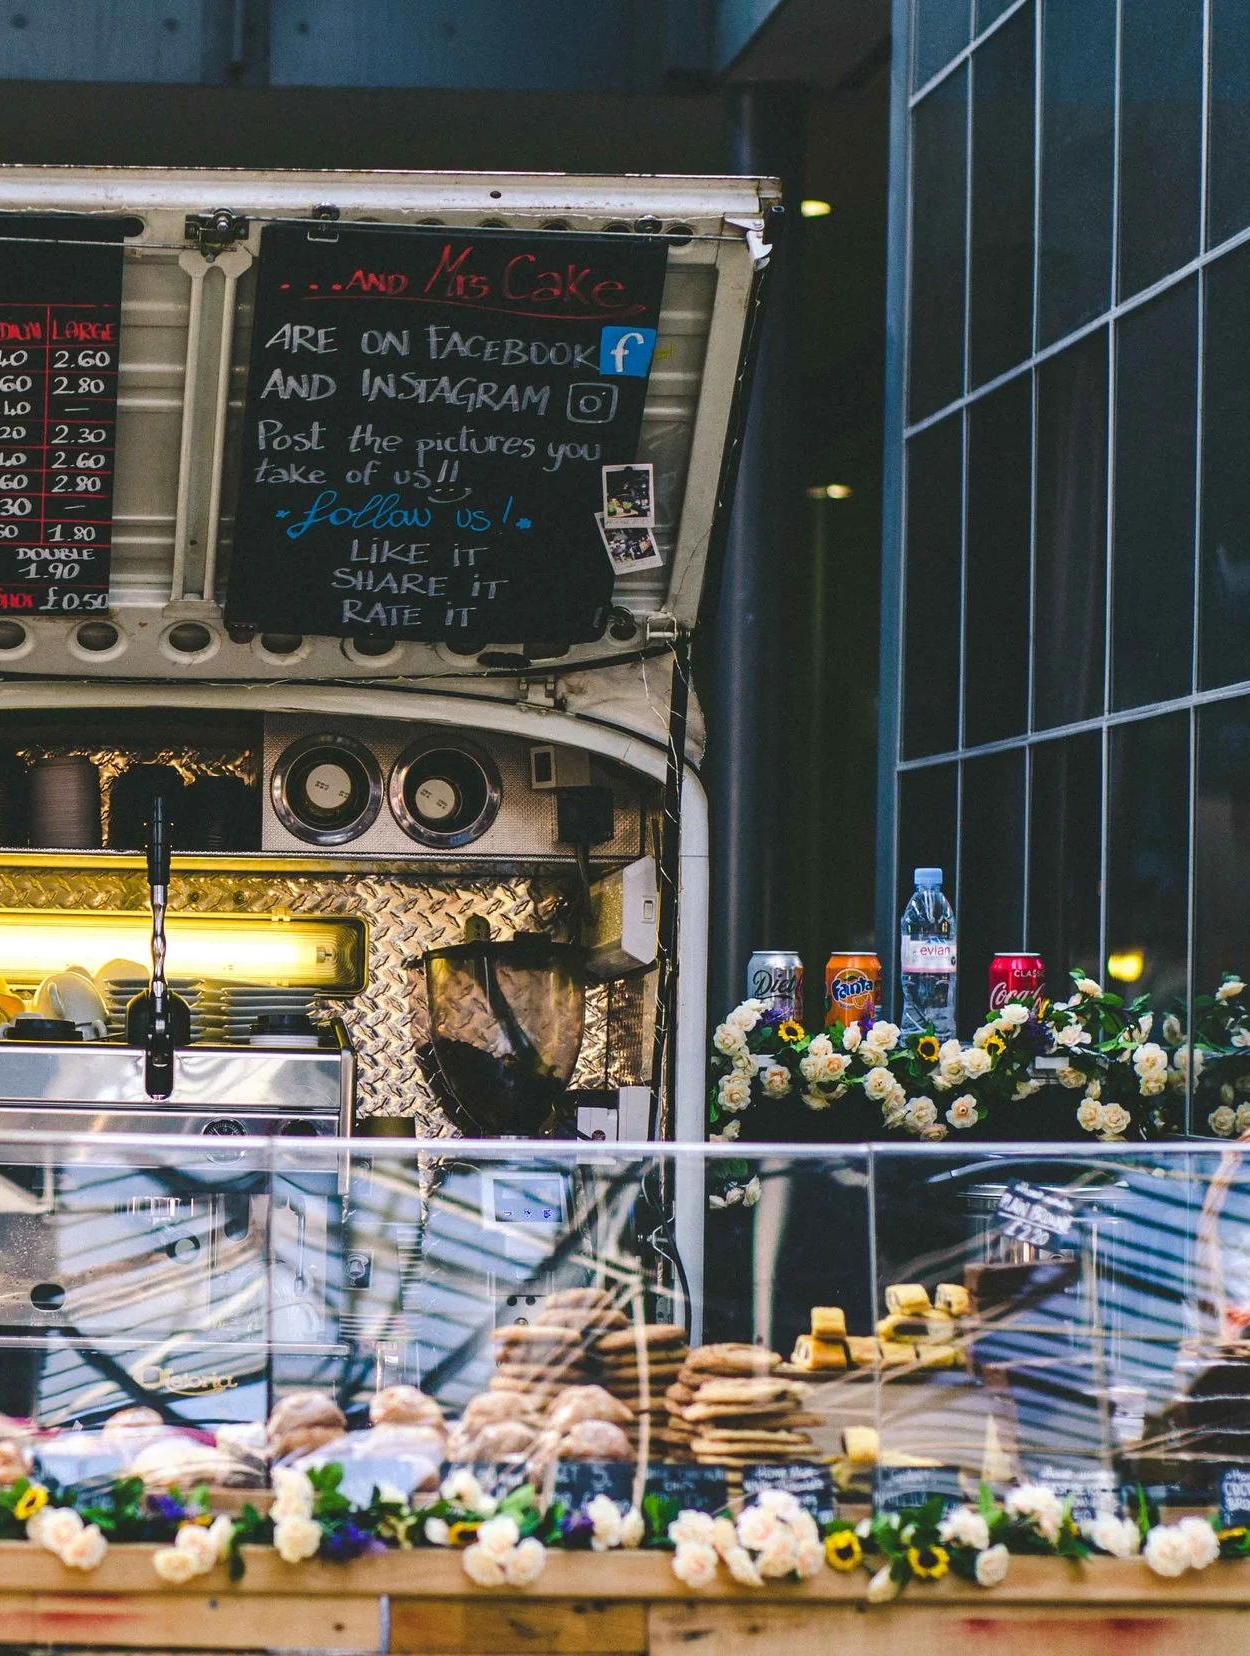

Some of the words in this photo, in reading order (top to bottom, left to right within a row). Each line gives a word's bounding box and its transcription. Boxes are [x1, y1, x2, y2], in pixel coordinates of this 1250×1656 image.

[424, 244, 490, 298] Mrs
[503, 252, 626, 307] Cake
[52, 318, 117, 341] LARGE
[264, 322, 338, 354] ARE
[360, 328, 411, 357] ON
[423, 324, 600, 371] FACEBOOK
[52, 349, 112, 368] 2.60
[52, 376, 105, 395] 2.80
[260, 367, 338, 401] AND
[360, 367, 551, 416] INSTAGRAM
[51, 426, 107, 444] 2.30
[256, 418, 327, 451] Post
[347, 420, 403, 452] the
[416, 425, 536, 469] pictures
[542, 439, 602, 472] you
[50, 452, 106, 469] 2.60
[52, 475, 102, 493] 2.80
[253, 459, 327, 485] take
[345, 459, 382, 486] of
[46, 524, 97, 543] 1.80
[14, 546, 97, 561] DOUBLE
[17, 562, 81, 580] 1.90
[330, 567, 449, 597] SHARE
[38, 586, 110, 611] £0.50
[341, 599, 422, 627] RATE
[919, 944, 951, 957] evian
[831, 976, 874, 1003] Fanta
